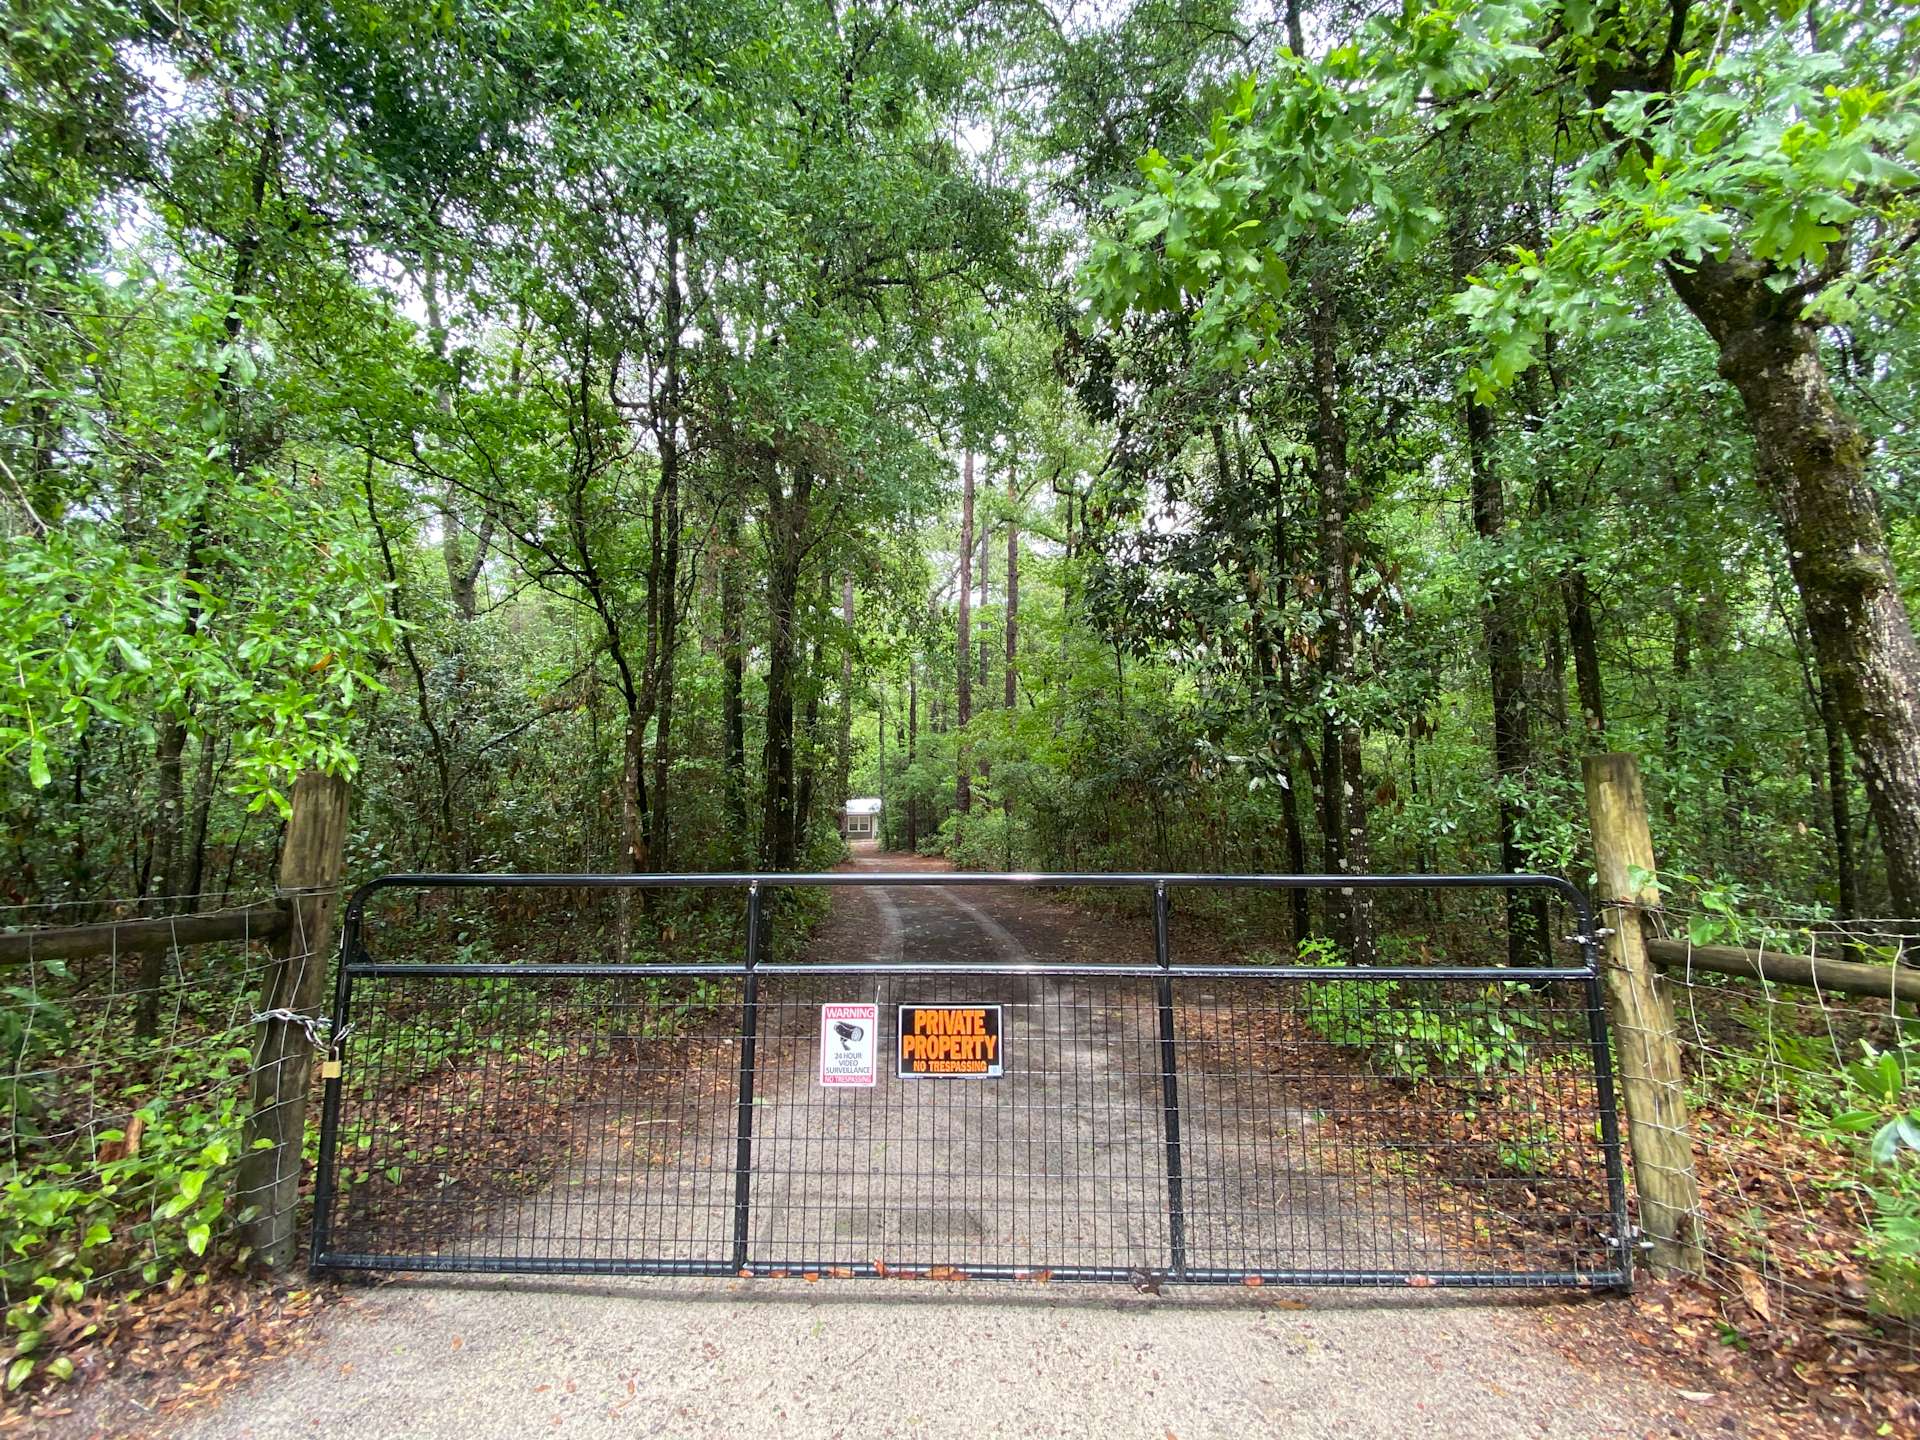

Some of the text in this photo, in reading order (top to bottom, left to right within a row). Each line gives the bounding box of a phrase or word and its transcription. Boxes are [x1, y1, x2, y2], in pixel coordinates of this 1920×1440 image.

[826, 1007, 874, 1018] WARNING
[914, 1009, 986, 1035] PRIVATE
[903, 1035, 997, 1060] PROPERTY
[913, 1060, 988, 1072] NO TRESPASSING
